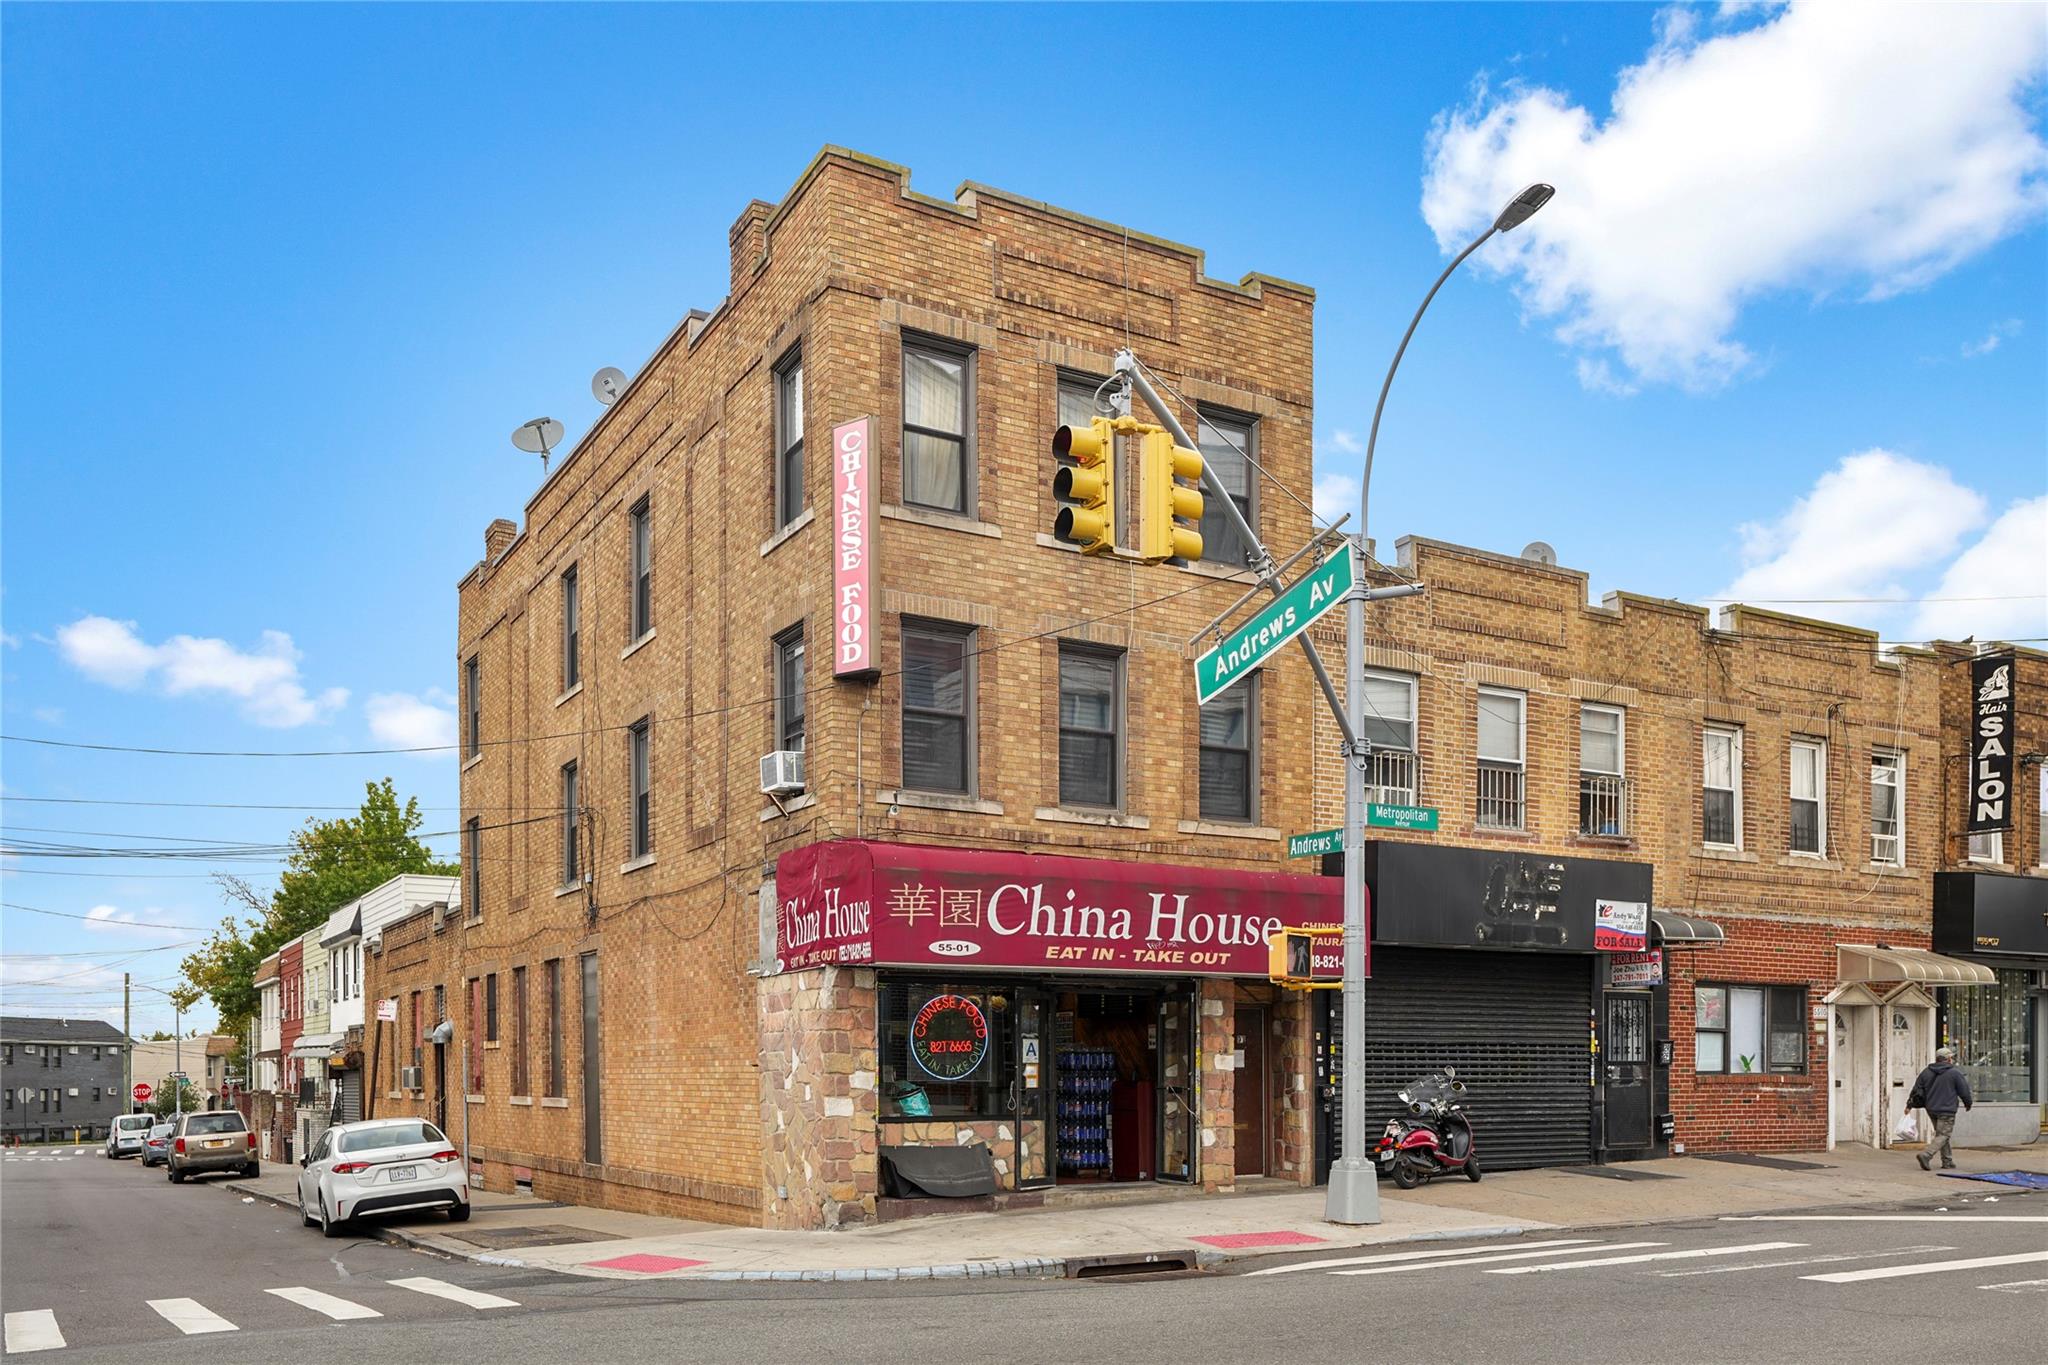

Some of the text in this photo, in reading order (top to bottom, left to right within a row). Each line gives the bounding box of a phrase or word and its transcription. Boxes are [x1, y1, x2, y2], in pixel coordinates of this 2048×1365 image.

[840, 430, 862, 664] CHINESE FOOD
[1214, 573, 1335, 682] Andrews Av
[1979, 701, 2008, 715] Hair
[1977, 716, 2007, 821] SALON
[1376, 806, 1428, 822] Metropolitan
[1290, 835, 1331, 855] Andrews
[886, 882, 983, 928] 華園
[987, 883, 1283, 946] China House
[785, 896, 820, 949] China
[824, 887, 870, 938] House
[938, 943, 970, 952] 55-01
[1596, 936, 1645, 948] FOR SALE
[821, 948, 837, 961] OUT
[1046, 946, 1086, 960] EAT
[1092, 948, 1114, 961] IN
[1133, 949, 1184, 963] TAKE
[1190, 951, 1231, 965] OUT
[915, 996, 987, 1039] CHINESE FOOD
[930, 1041, 946, 1053] 821
[1026, 1042, 1037, 1056] A
[916, 1040, 983, 1076] EAT IN TAKE OUT
[134, 1089, 151, 1097] STOP
